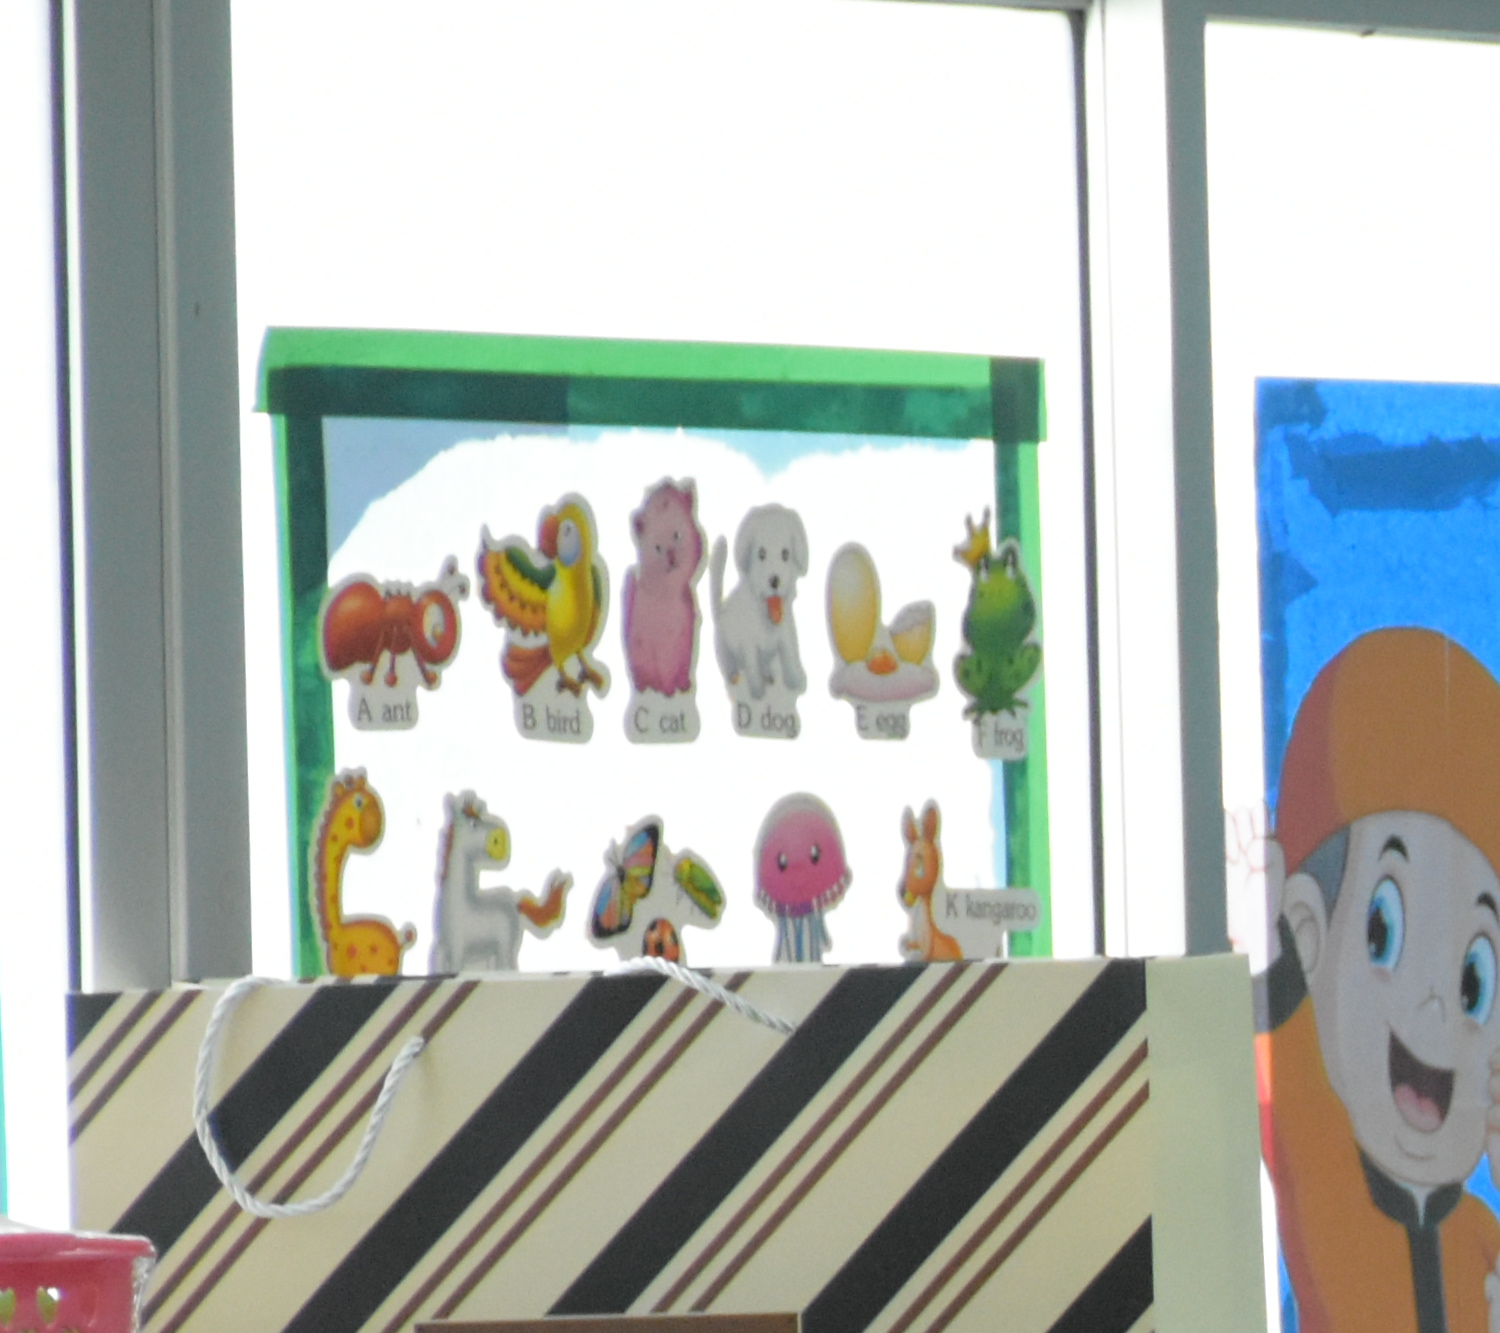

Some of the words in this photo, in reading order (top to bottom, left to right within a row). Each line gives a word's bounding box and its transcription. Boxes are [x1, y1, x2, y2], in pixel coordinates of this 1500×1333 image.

[357, 698, 373, 722] A
[382, 701, 412, 722] ant
[522, 703, 537, 730] B
[546, 705, 581, 735] bird
[634, 706, 649, 734] C
[659, 711, 687, 733] cat
[737, 703, 752, 729] D
[761, 706, 797, 736] dog
[856, 705, 869, 732] E
[876, 712, 907, 736] egg
[945, 892, 959, 919] K
[965, 892, 1037, 927] kangaroo
